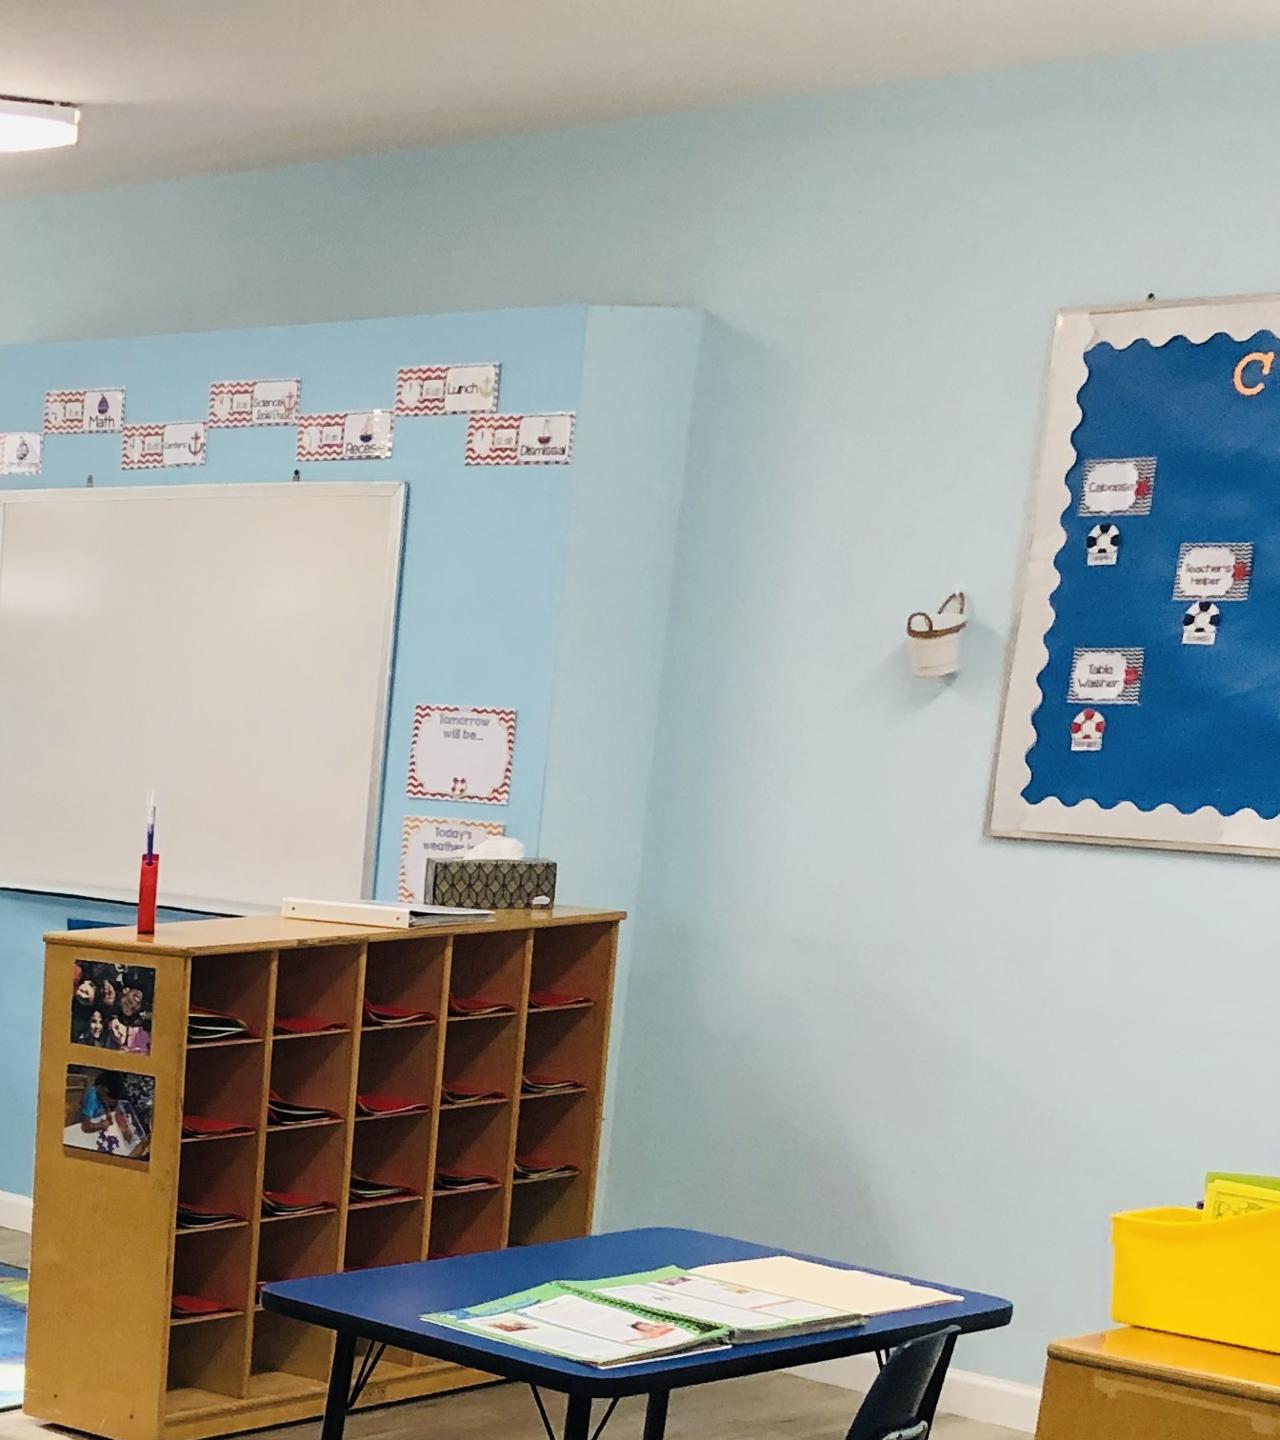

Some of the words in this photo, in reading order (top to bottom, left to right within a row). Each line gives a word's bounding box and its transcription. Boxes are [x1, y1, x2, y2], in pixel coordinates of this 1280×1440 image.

[1233, 351, 1275, 397] C
[447, 382, 479, 396] Lunch
[89, 415, 115, 429] Math
[519, 444, 568, 457] Dismissal
[1190, 576, 1221, 587] Helper
[1088, 663, 1114, 676] Table
[1077, 679, 1121, 689] Washer
[439, 713, 491, 727] Tomorrow
[443, 729, 461, 740] will
[434, 826, 472, 842] Today's
[423, 841, 465, 852] weather
